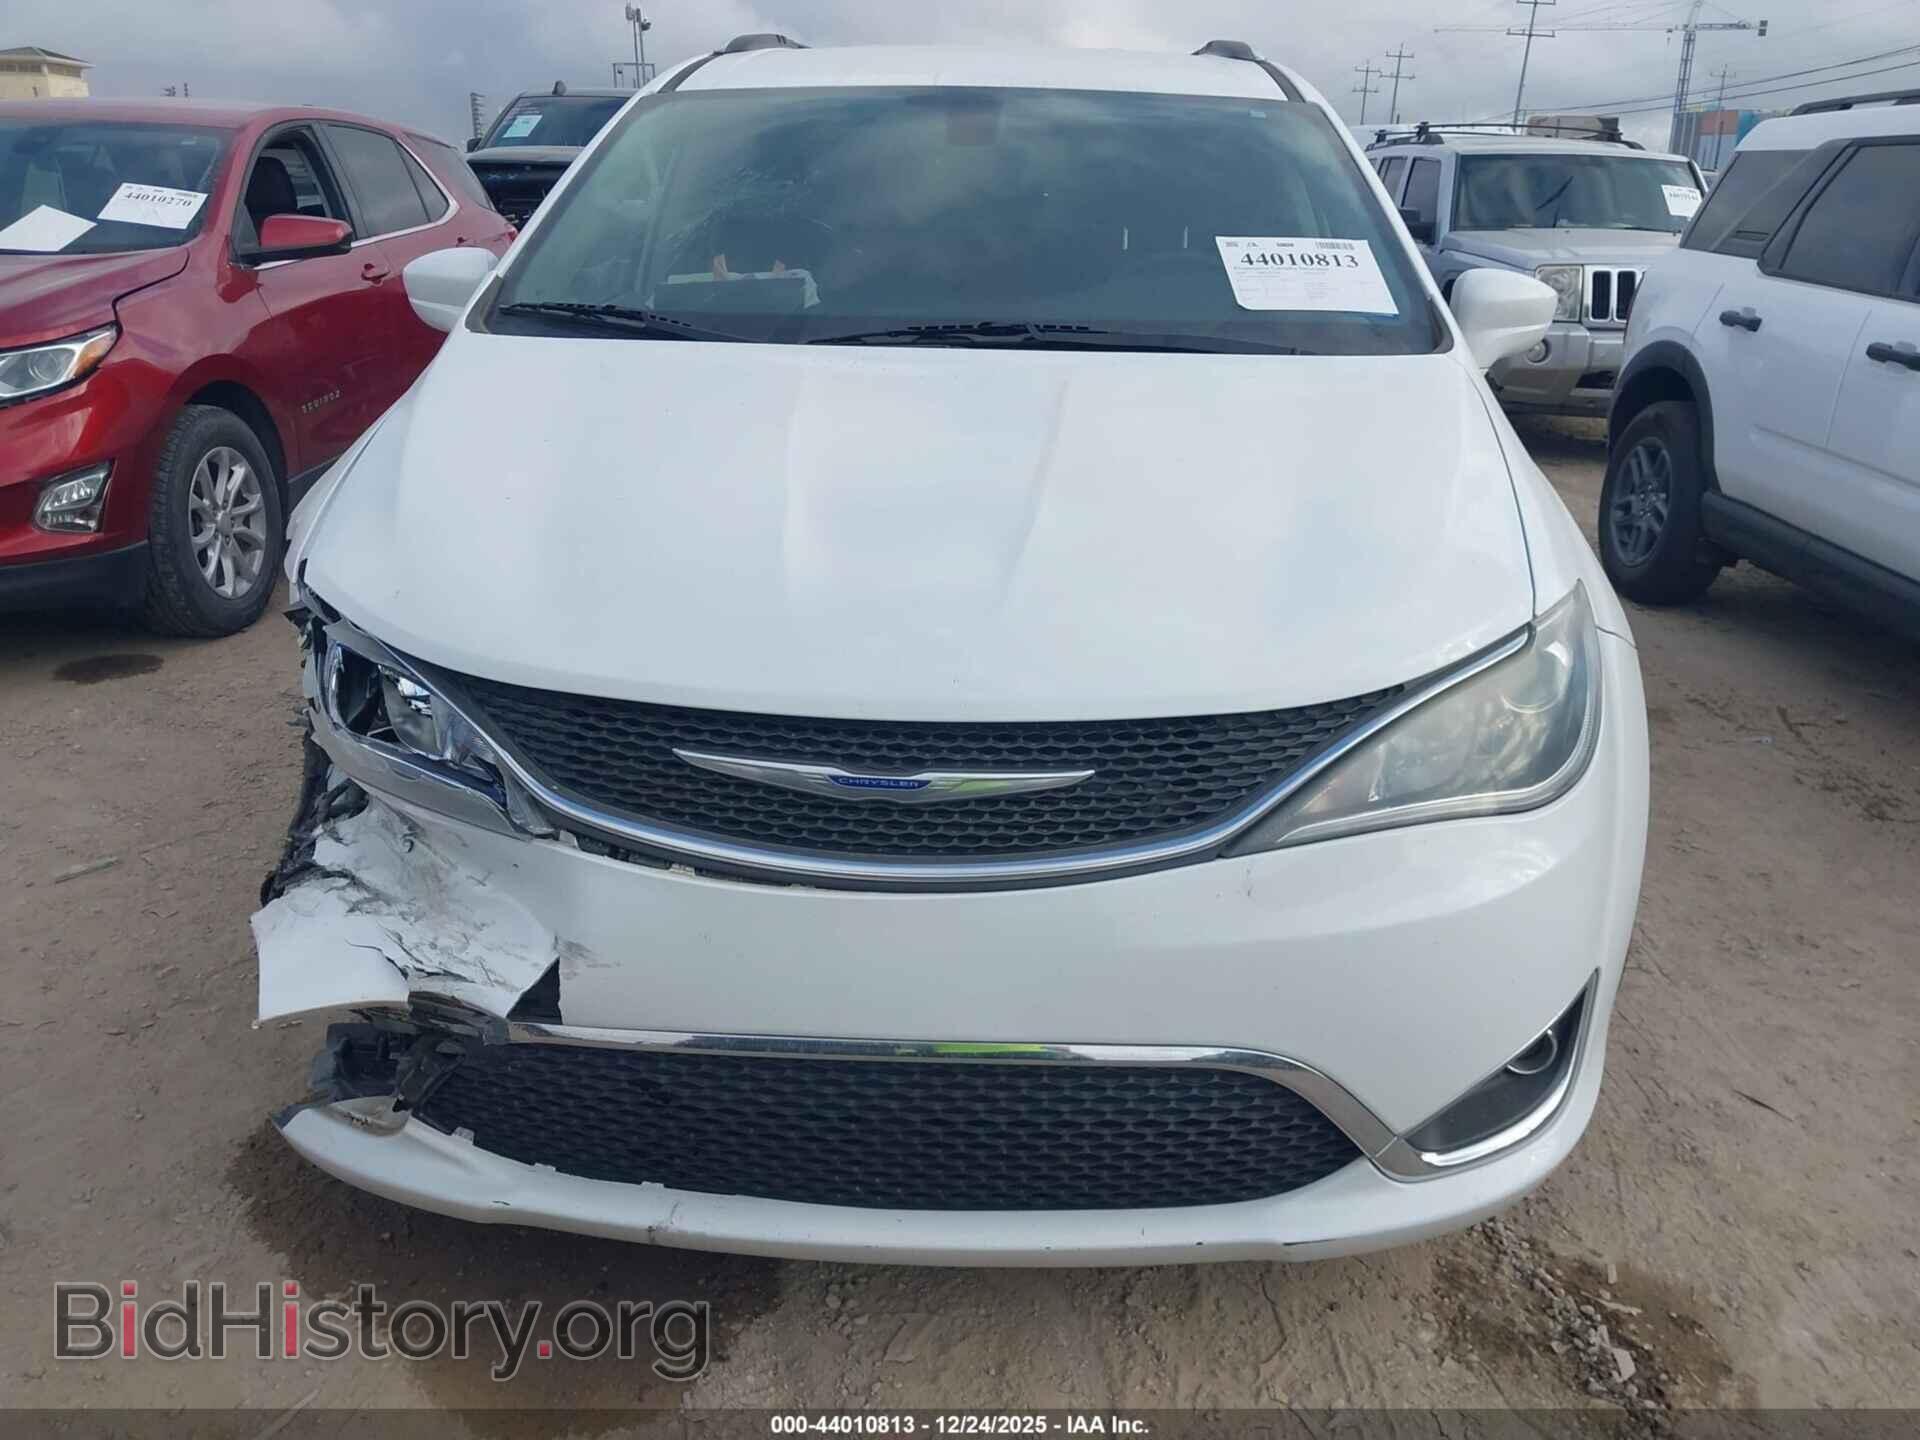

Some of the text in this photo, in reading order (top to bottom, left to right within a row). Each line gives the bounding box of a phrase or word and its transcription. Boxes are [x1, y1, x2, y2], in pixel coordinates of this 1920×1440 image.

[124, 192, 193, 207] 44010270
[1240, 252, 1359, 268] 44010813
[839, 778, 919, 787] CHRYSLER
